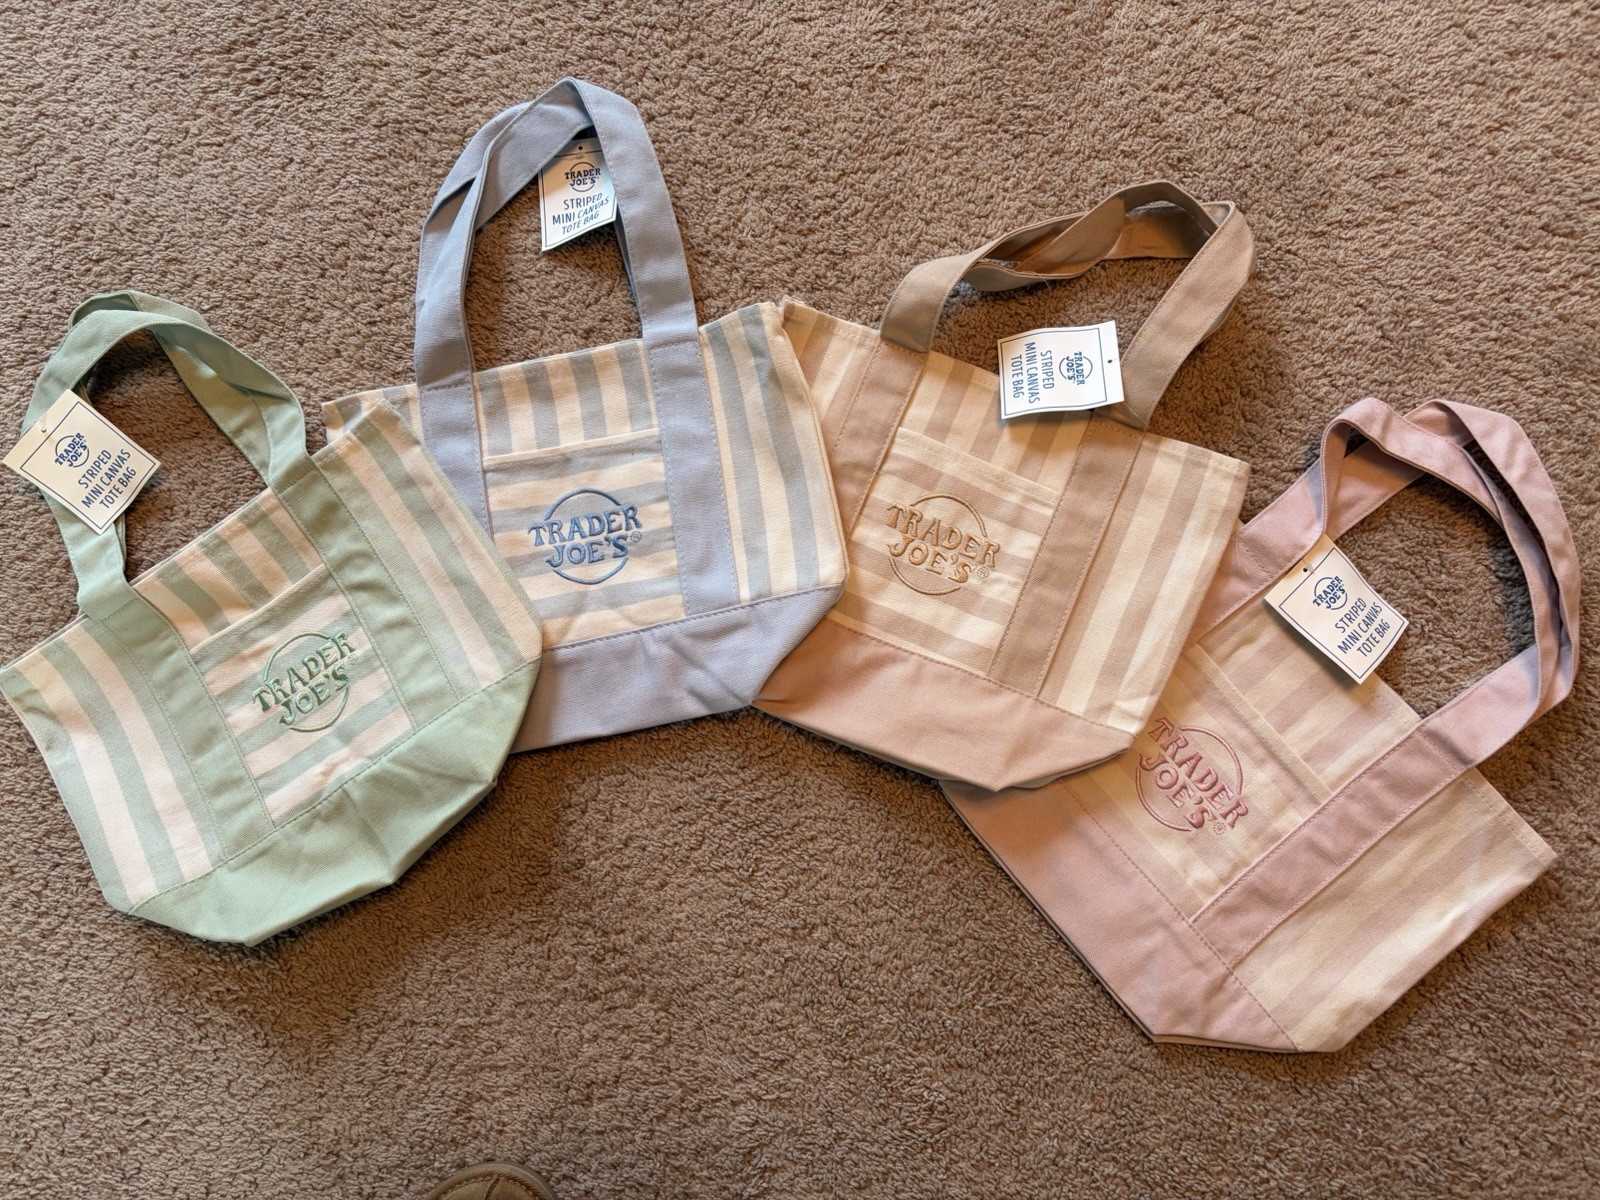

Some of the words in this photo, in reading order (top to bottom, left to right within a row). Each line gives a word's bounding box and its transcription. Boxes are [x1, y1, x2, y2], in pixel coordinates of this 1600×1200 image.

[565, 168, 601, 179] TRADER
[570, 177, 597, 186] JOE'S
[553, 212, 575, 225] MINI
[578, 196, 609, 219] CANVAS
[564, 193, 602, 210] STRIPED
[562, 221, 580, 234] TOTE
[584, 211, 599, 224] BAG
[1011, 355, 1023, 378] TOTE
[1025, 342, 1037, 366] MINI
[1041, 350, 1054, 389] STRIPED
[1066, 356, 1076, 381] JOE'S
[1074, 351, 1085, 386] TRADER
[1012, 380, 1024, 398] BAG
[1027, 367, 1040, 404] CANVAS
[55, 432, 84, 465] TRADER
[67, 442, 87, 467] JOE'S
[78, 450, 111, 489] STRIPED
[81, 484, 104, 508] MINI
[100, 449, 131, 486] CANVAS
[99, 485, 124, 509] TOTE
[118, 467, 137, 488] BAG
[528, 504, 642, 547] TRADER
[886, 503, 1000, 568] TRADER
[545, 534, 629, 568] JOE'S
[887, 534, 977, 584] JOE'S
[1312, 576, 1343, 607] TRADER
[1325, 585, 1346, 609] JOE'S
[1335, 597, 1367, 633] STRIPED
[1337, 630, 1362, 654] MINI
[1358, 602, 1382, 633] CANVAS
[1357, 634, 1380, 657] TOTE
[1375, 619, 1390, 638] BAG
[253, 632, 355, 713] TRADER
[279, 664, 349, 725] JOE'S
[1139, 752, 1217, 829] JOE'S
[1148, 717, 1248, 829] TRADER
